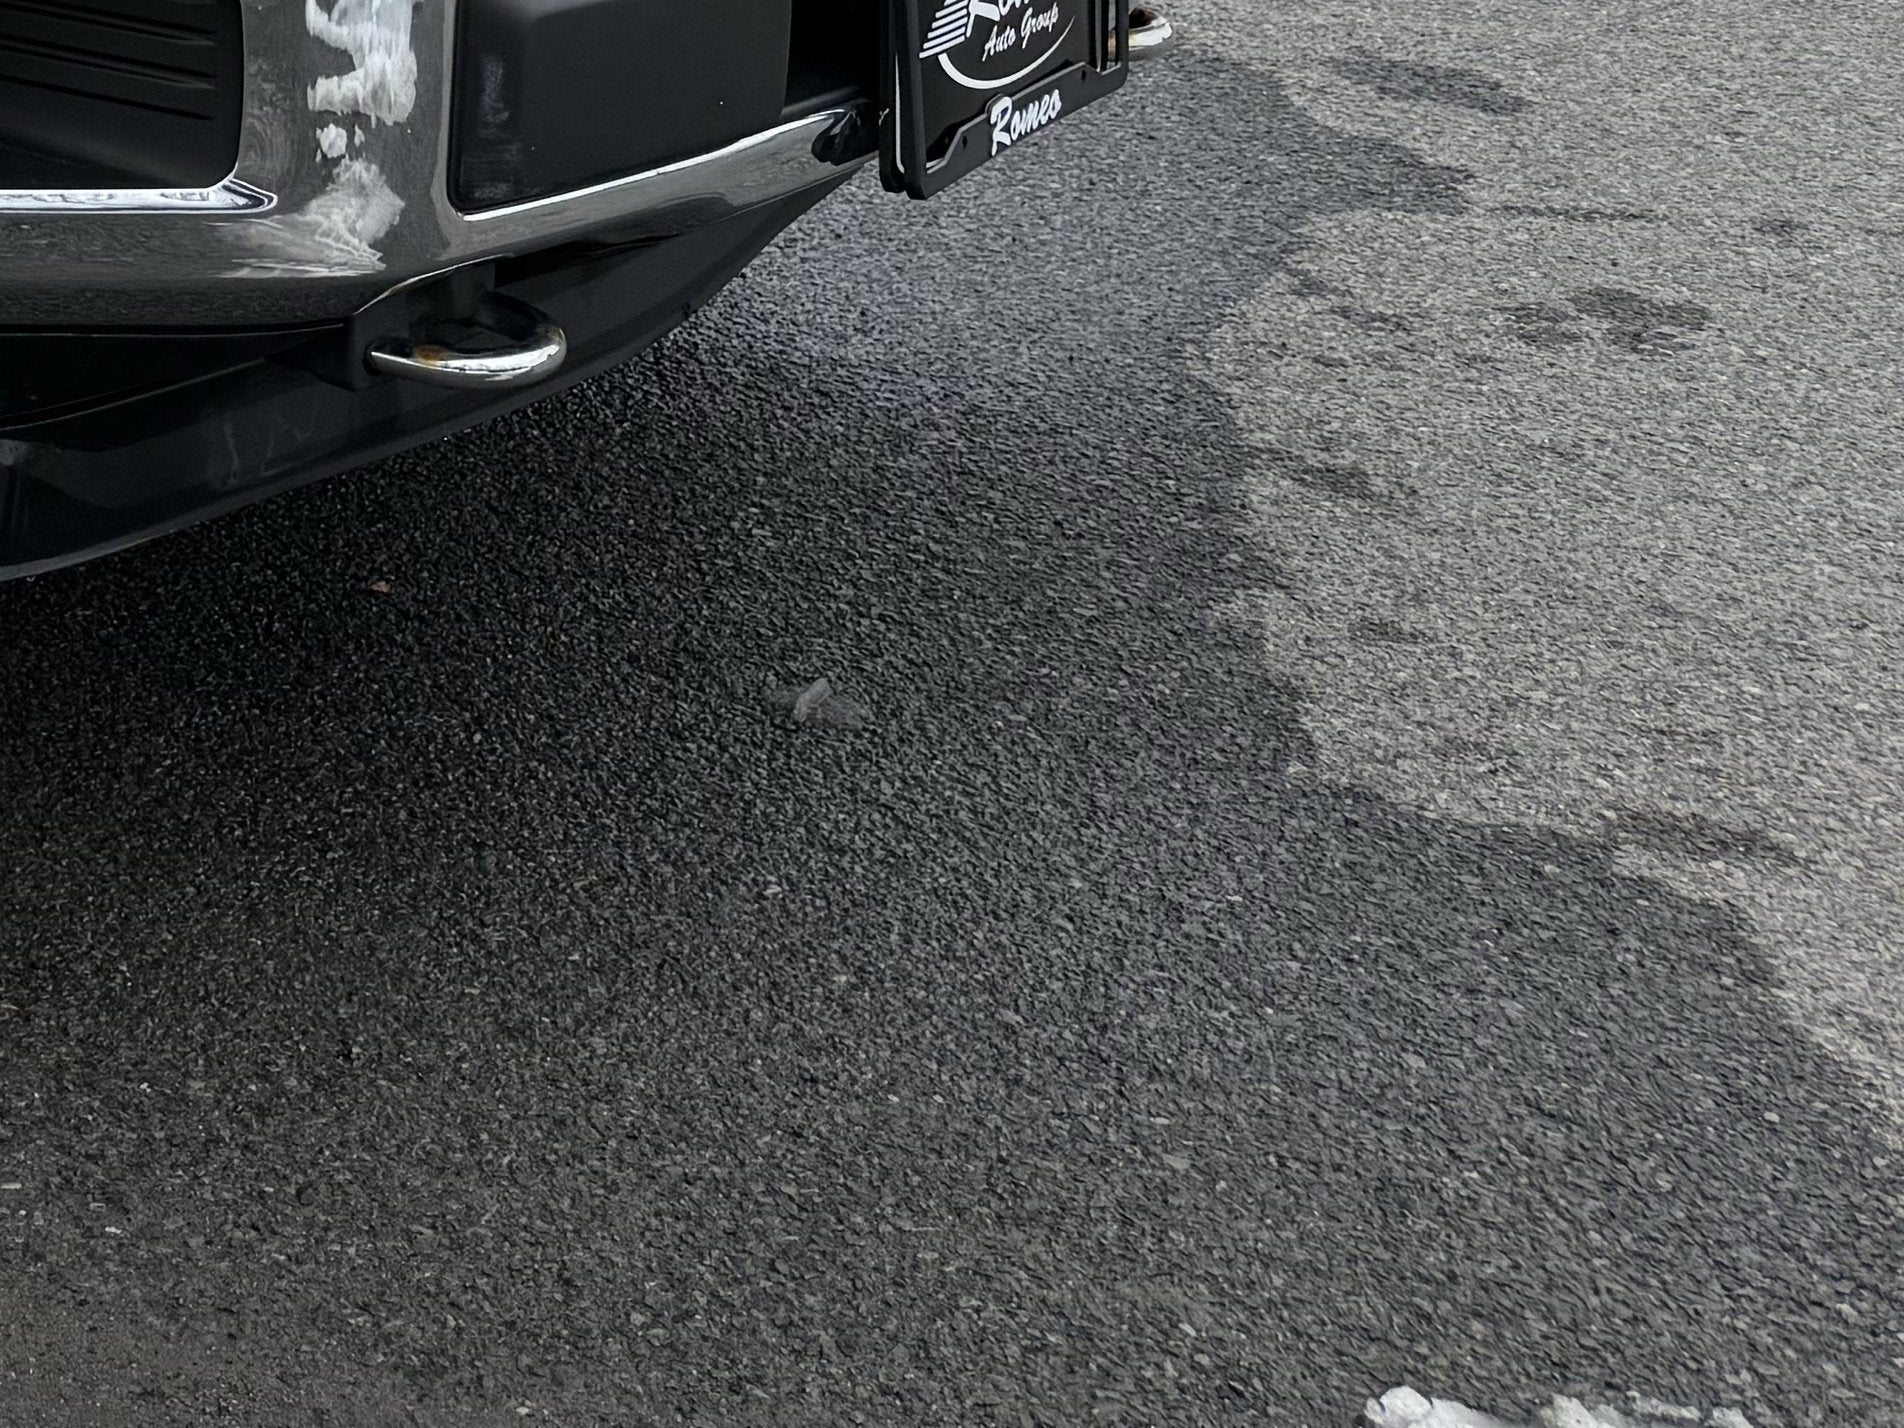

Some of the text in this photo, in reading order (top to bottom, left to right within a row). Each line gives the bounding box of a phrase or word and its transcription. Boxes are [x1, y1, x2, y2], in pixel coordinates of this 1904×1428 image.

[982, 2, 1060, 62] Auto Group
[990, 89, 1062, 157] Romeo
